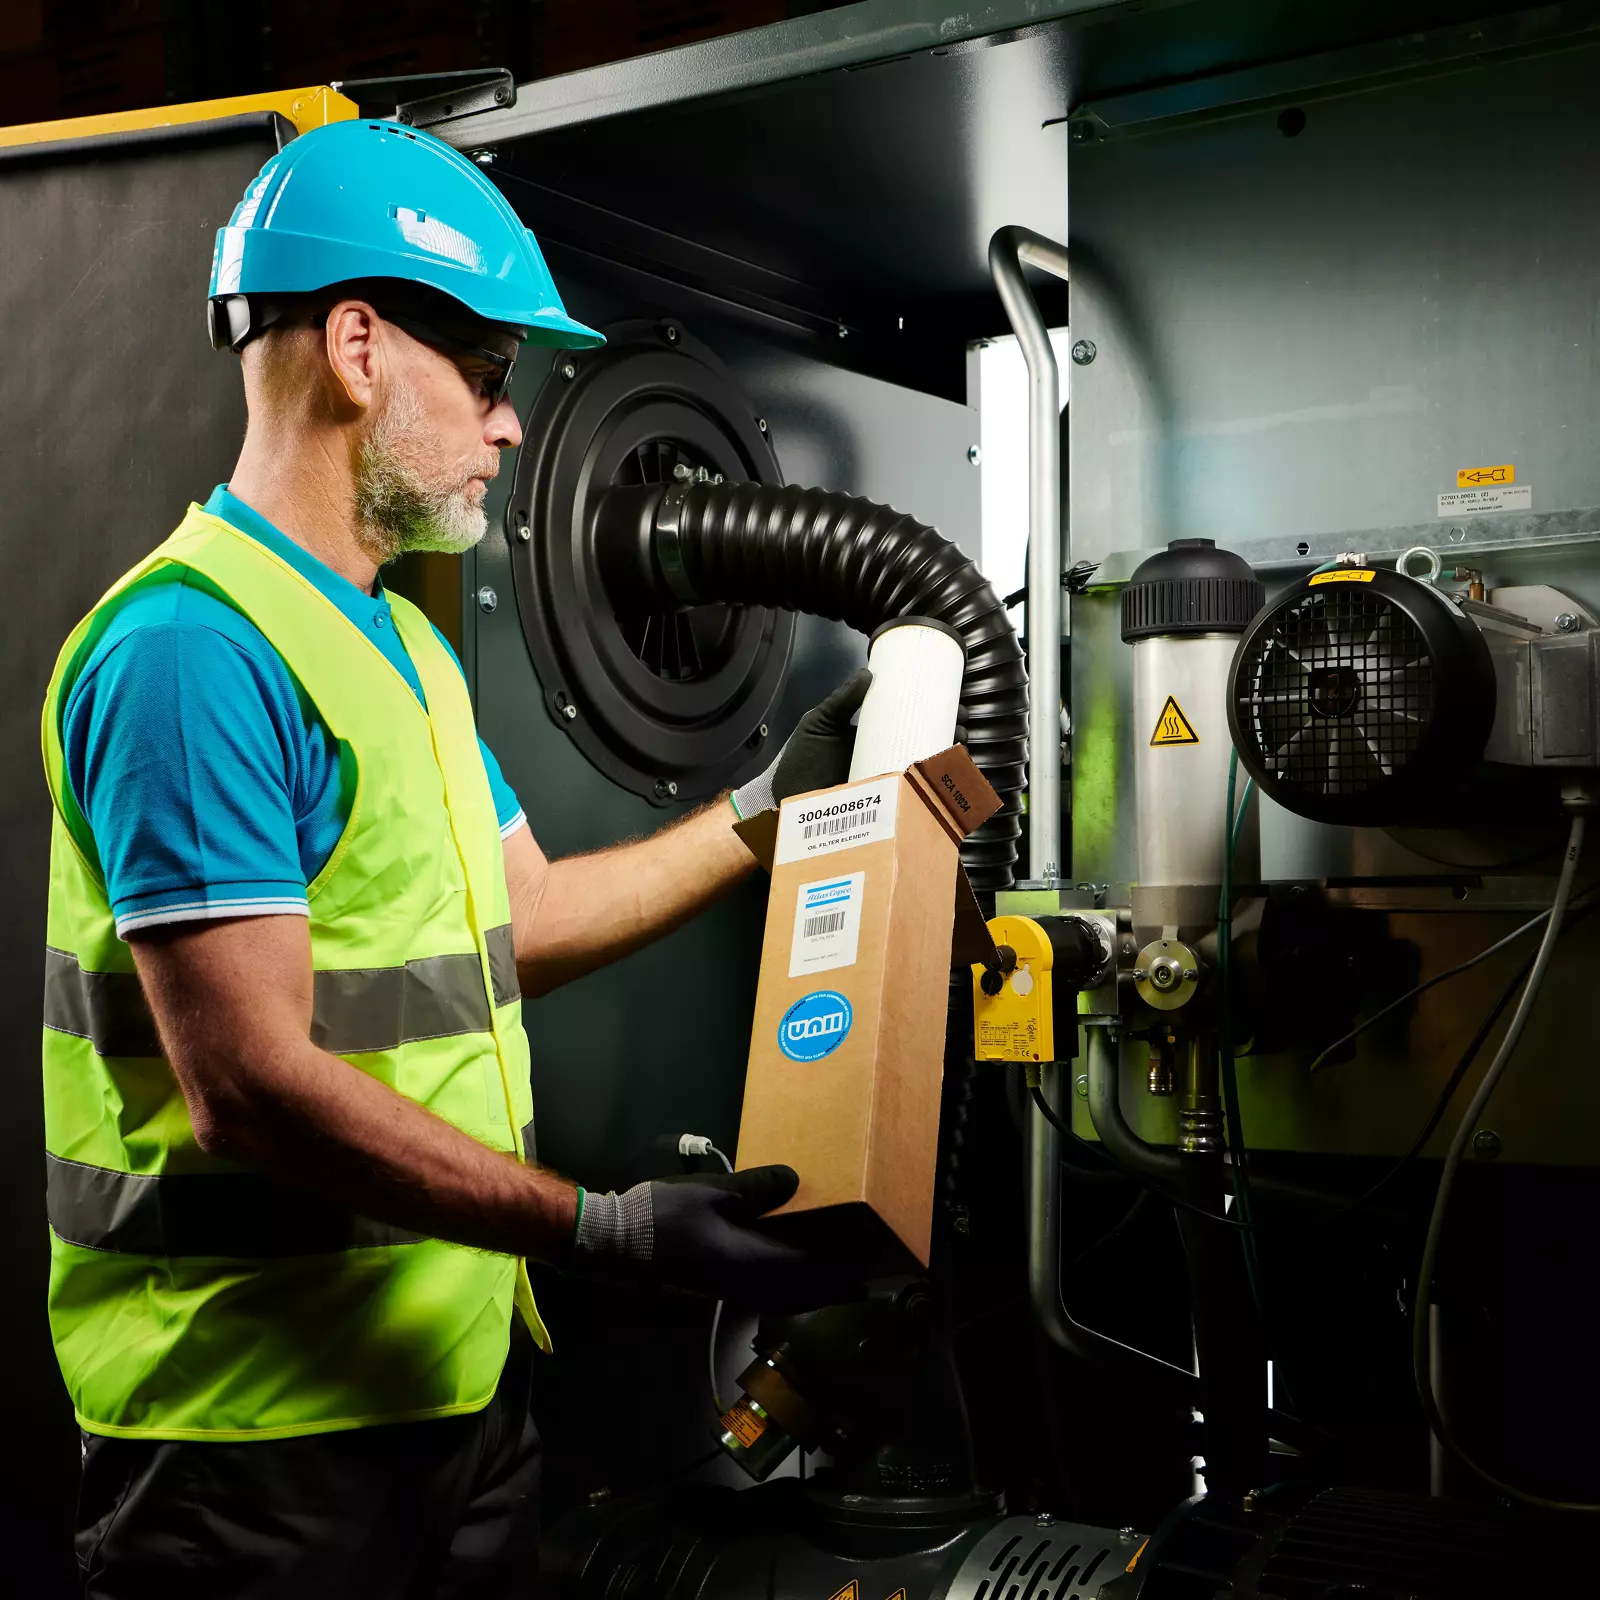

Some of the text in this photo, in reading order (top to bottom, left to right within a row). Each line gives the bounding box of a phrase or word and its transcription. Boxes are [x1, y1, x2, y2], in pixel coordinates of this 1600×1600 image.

[941, 774, 971, 813] SCA 10034
[798, 794, 882, 824] 3004008674
[818, 839, 840, 848] FILTER
[840, 832, 870, 843] ELEMENT
[807, 887, 852, 901] Atlas Copco
